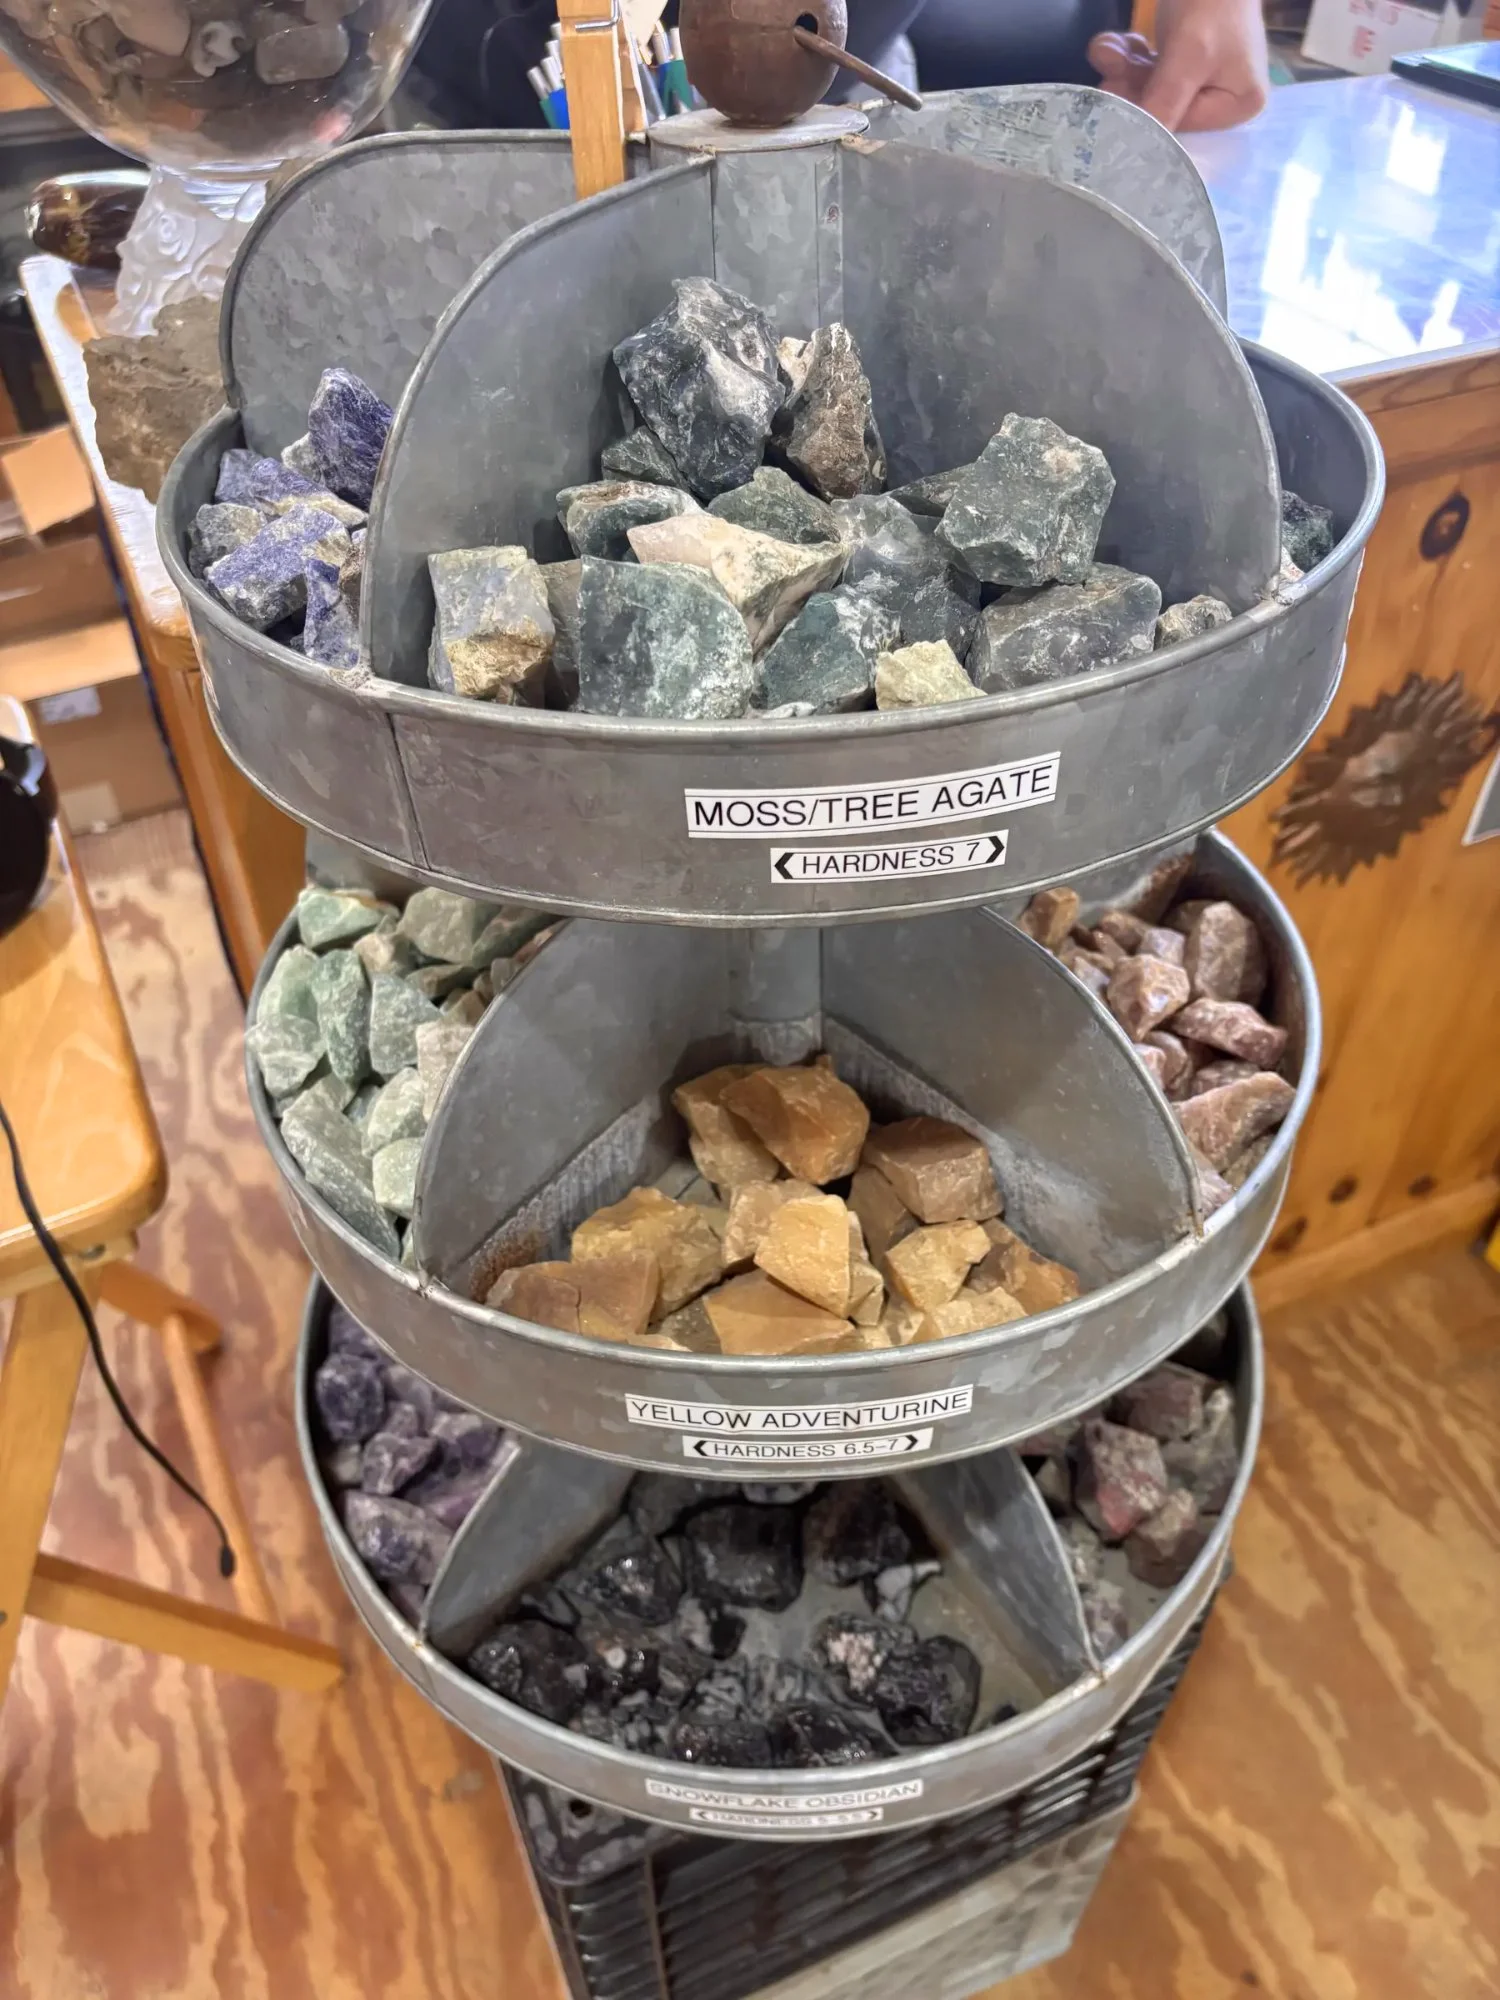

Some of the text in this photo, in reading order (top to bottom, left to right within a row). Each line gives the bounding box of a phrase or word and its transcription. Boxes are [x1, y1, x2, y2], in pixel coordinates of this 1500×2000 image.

[694, 765, 1053, 827] MOSS/TREE AGATE
[802, 842, 981, 875] HARDNESS 7
[632, 1393, 968, 1429] YELLOW ADVENTURINE
[714, 1442, 836, 1458] HARDNESS
[650, 1781, 919, 1809] SNOWFLAKE OBSIDIAN
